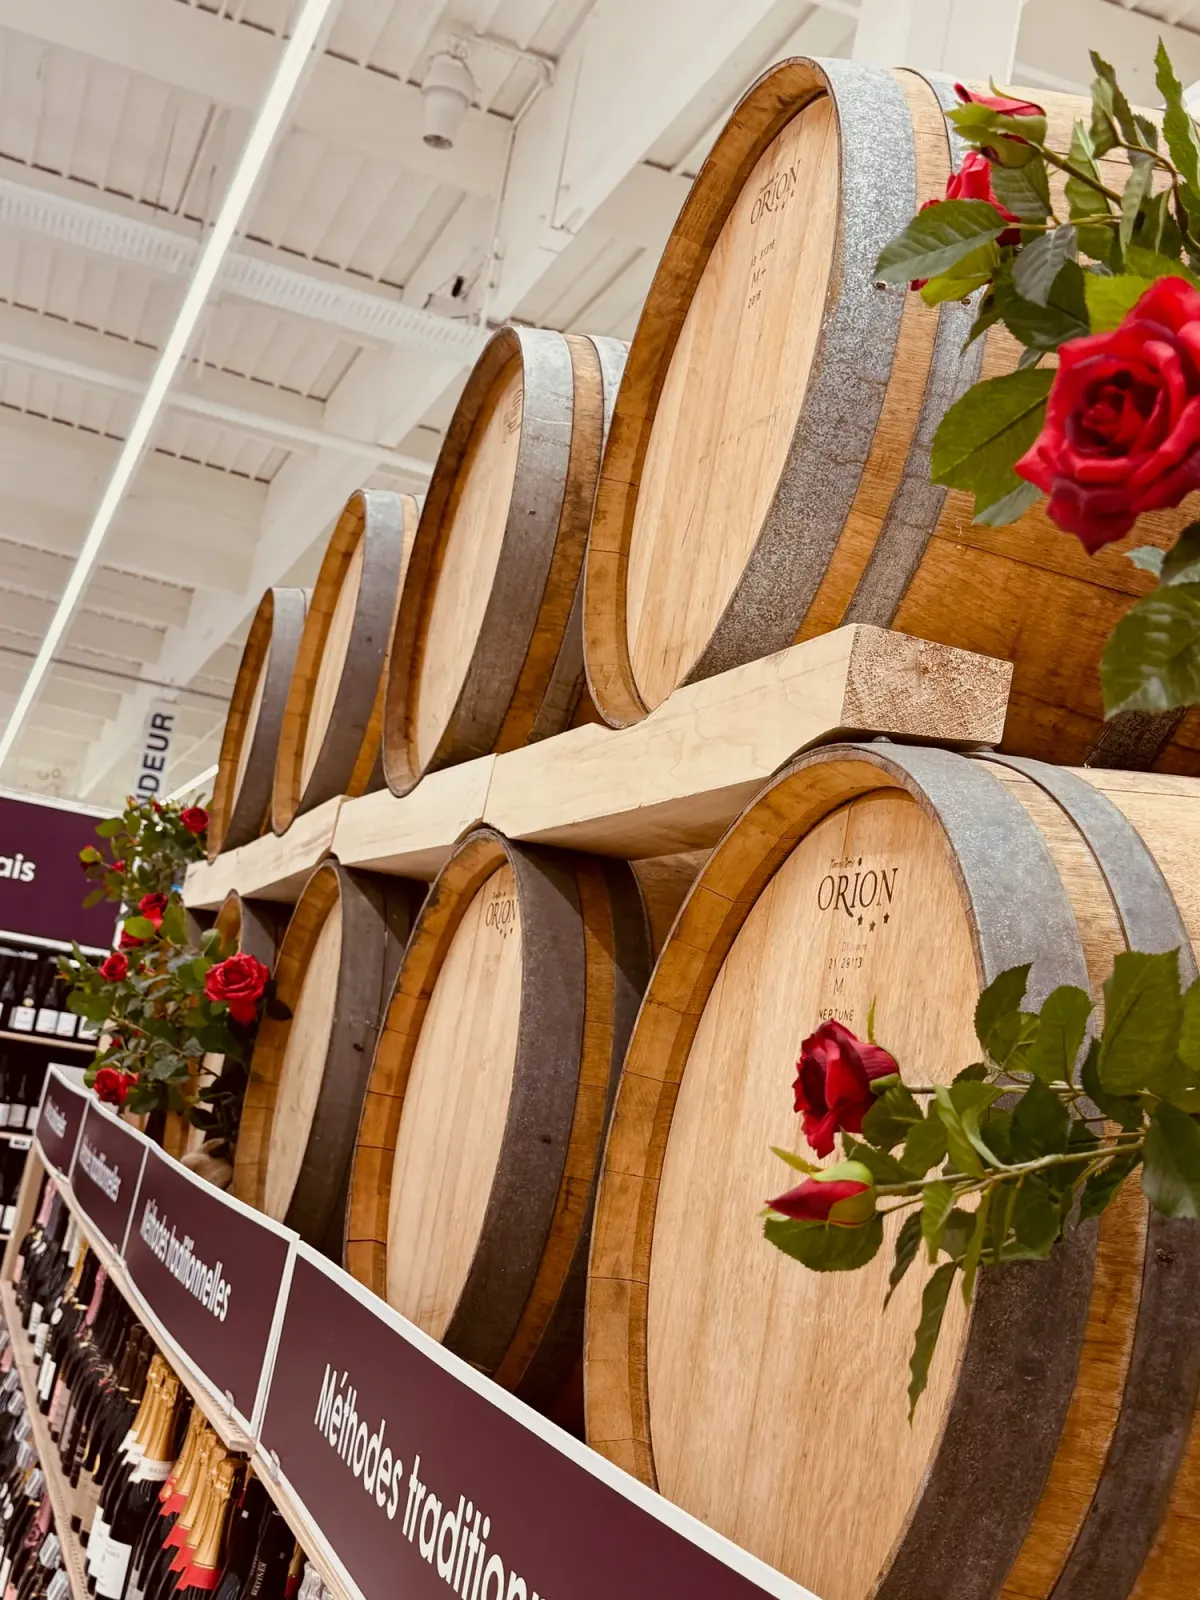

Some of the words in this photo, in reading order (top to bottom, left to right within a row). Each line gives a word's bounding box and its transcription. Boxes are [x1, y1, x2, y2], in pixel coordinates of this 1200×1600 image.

[750, 160, 801, 225] ORION
[135, 711, 175, 808] NDEUR
[0, 853, 36, 882] ais
[817, 867, 898, 918] ORION
[485, 898, 519, 930] ORION
[833, 976, 844, 995] M
[818, 1008, 854, 1021] NEPTUNE
[165, 1224, 232, 1322] traditionnelles
[314, 1363, 404, 1520] Méthodes
[402, 1454, 546, 1600] tradition
